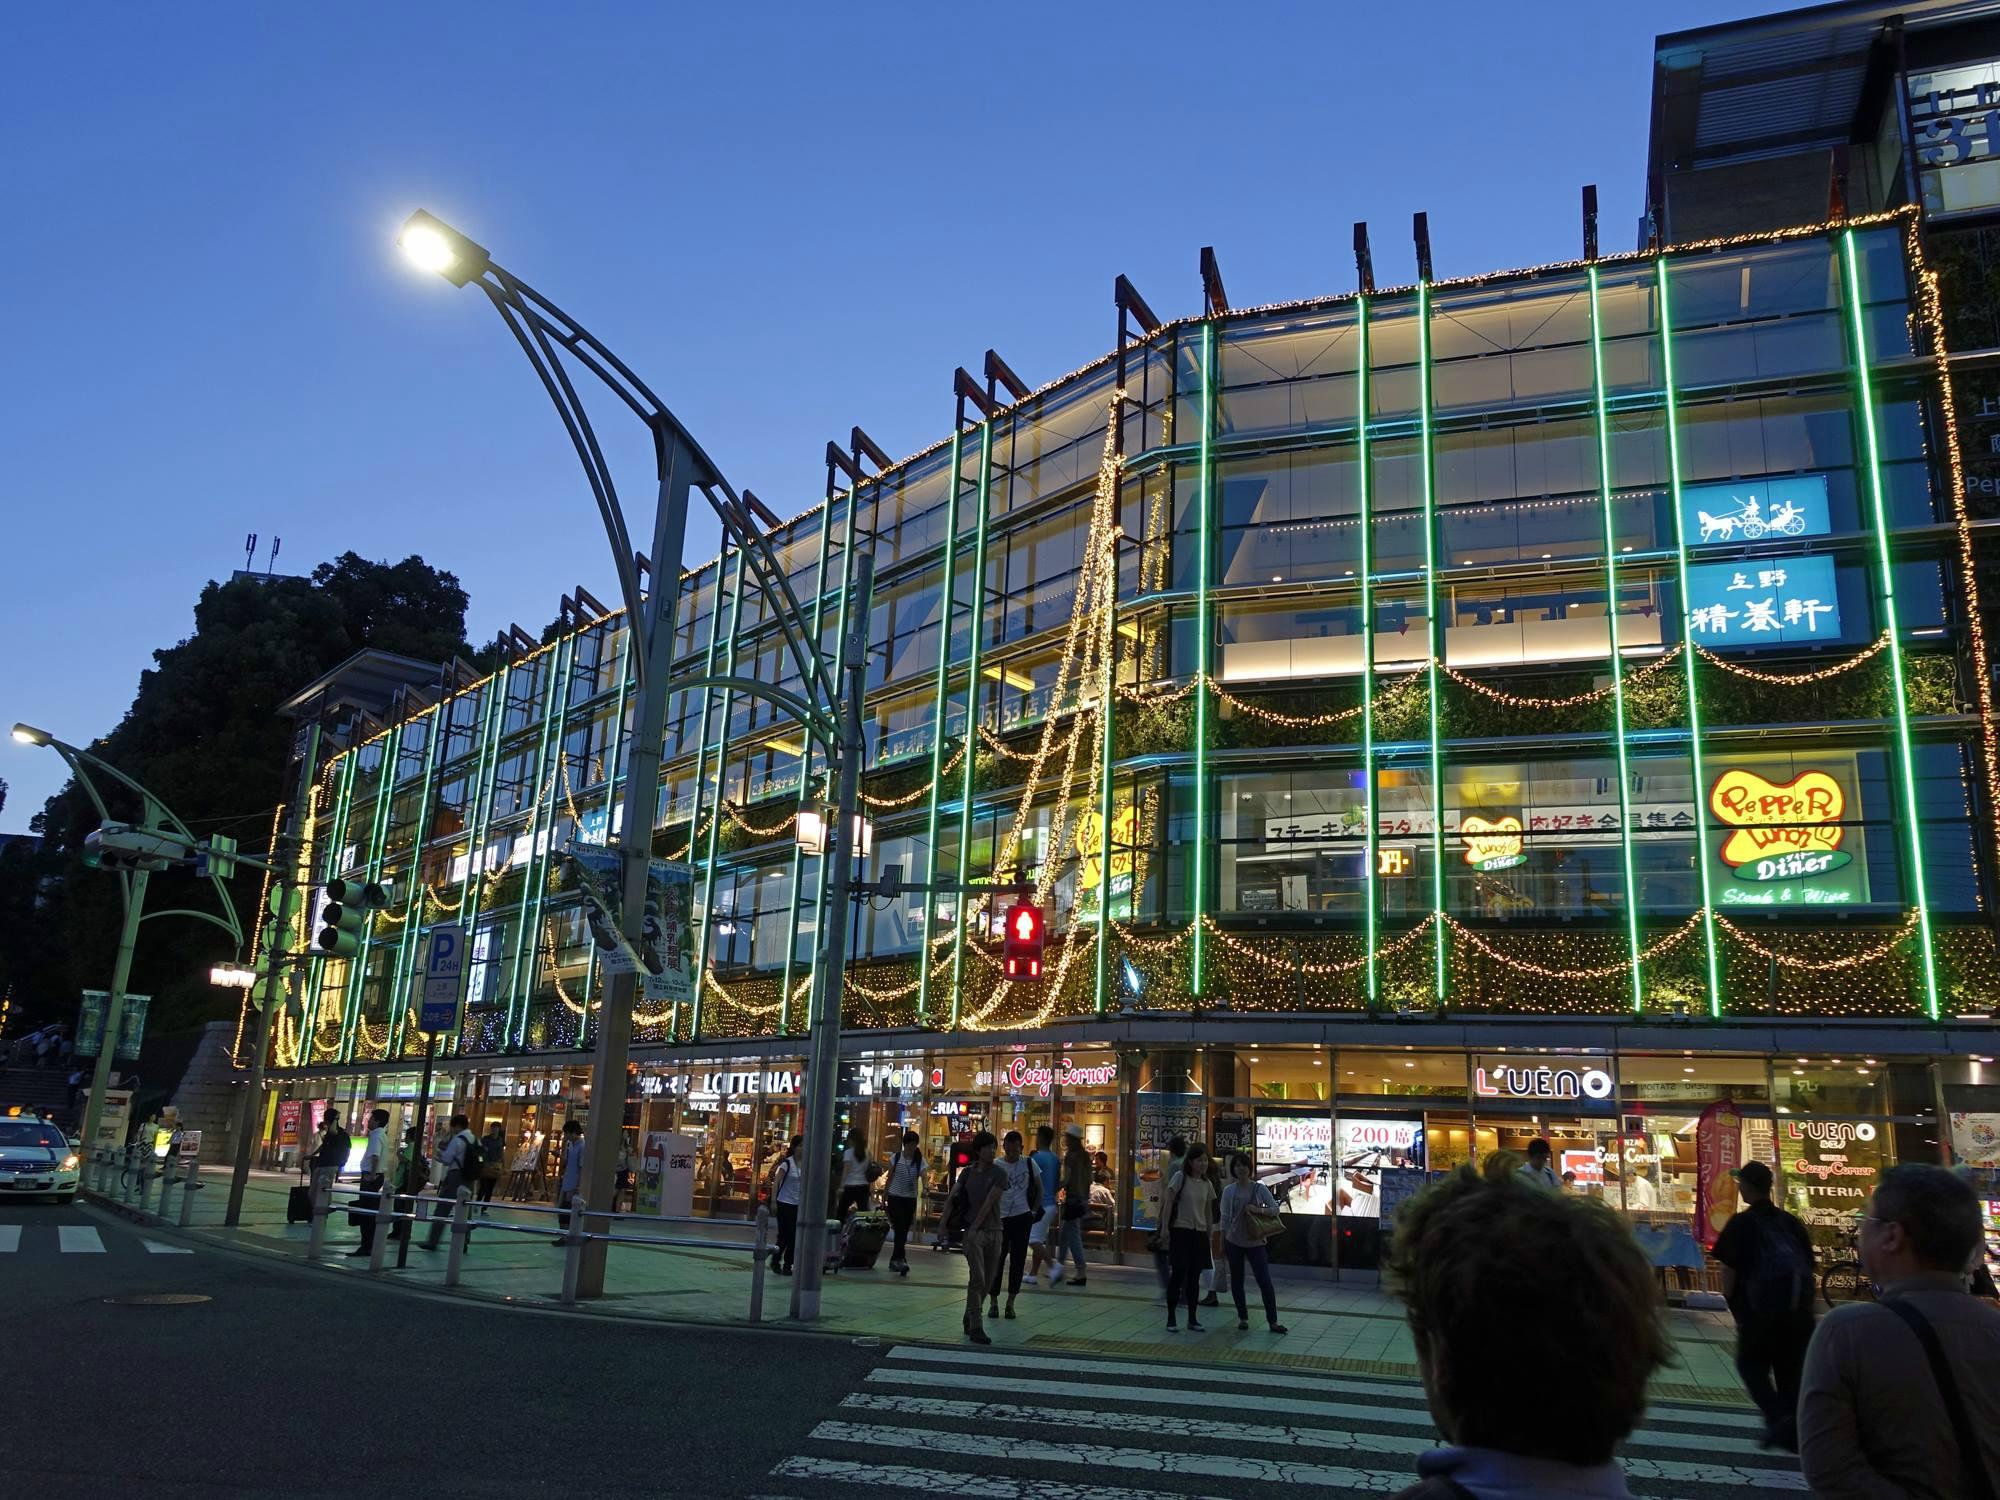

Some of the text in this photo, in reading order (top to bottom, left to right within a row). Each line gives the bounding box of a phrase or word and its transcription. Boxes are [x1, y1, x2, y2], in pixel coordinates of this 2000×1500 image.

[1727, 569, 1787, 591] 上野
[1757, 855, 1832, 880] Diner
[431, 934, 455, 972] P
[440, 960, 459, 972] 24H
[1010, 1057, 1054, 1097] Cozy
[1477, 1068, 1612, 1098] L'UENO
[1351, 1126, 1390, 1144] 200
[1788, 1186, 1865, 1197] LOTTERIA
